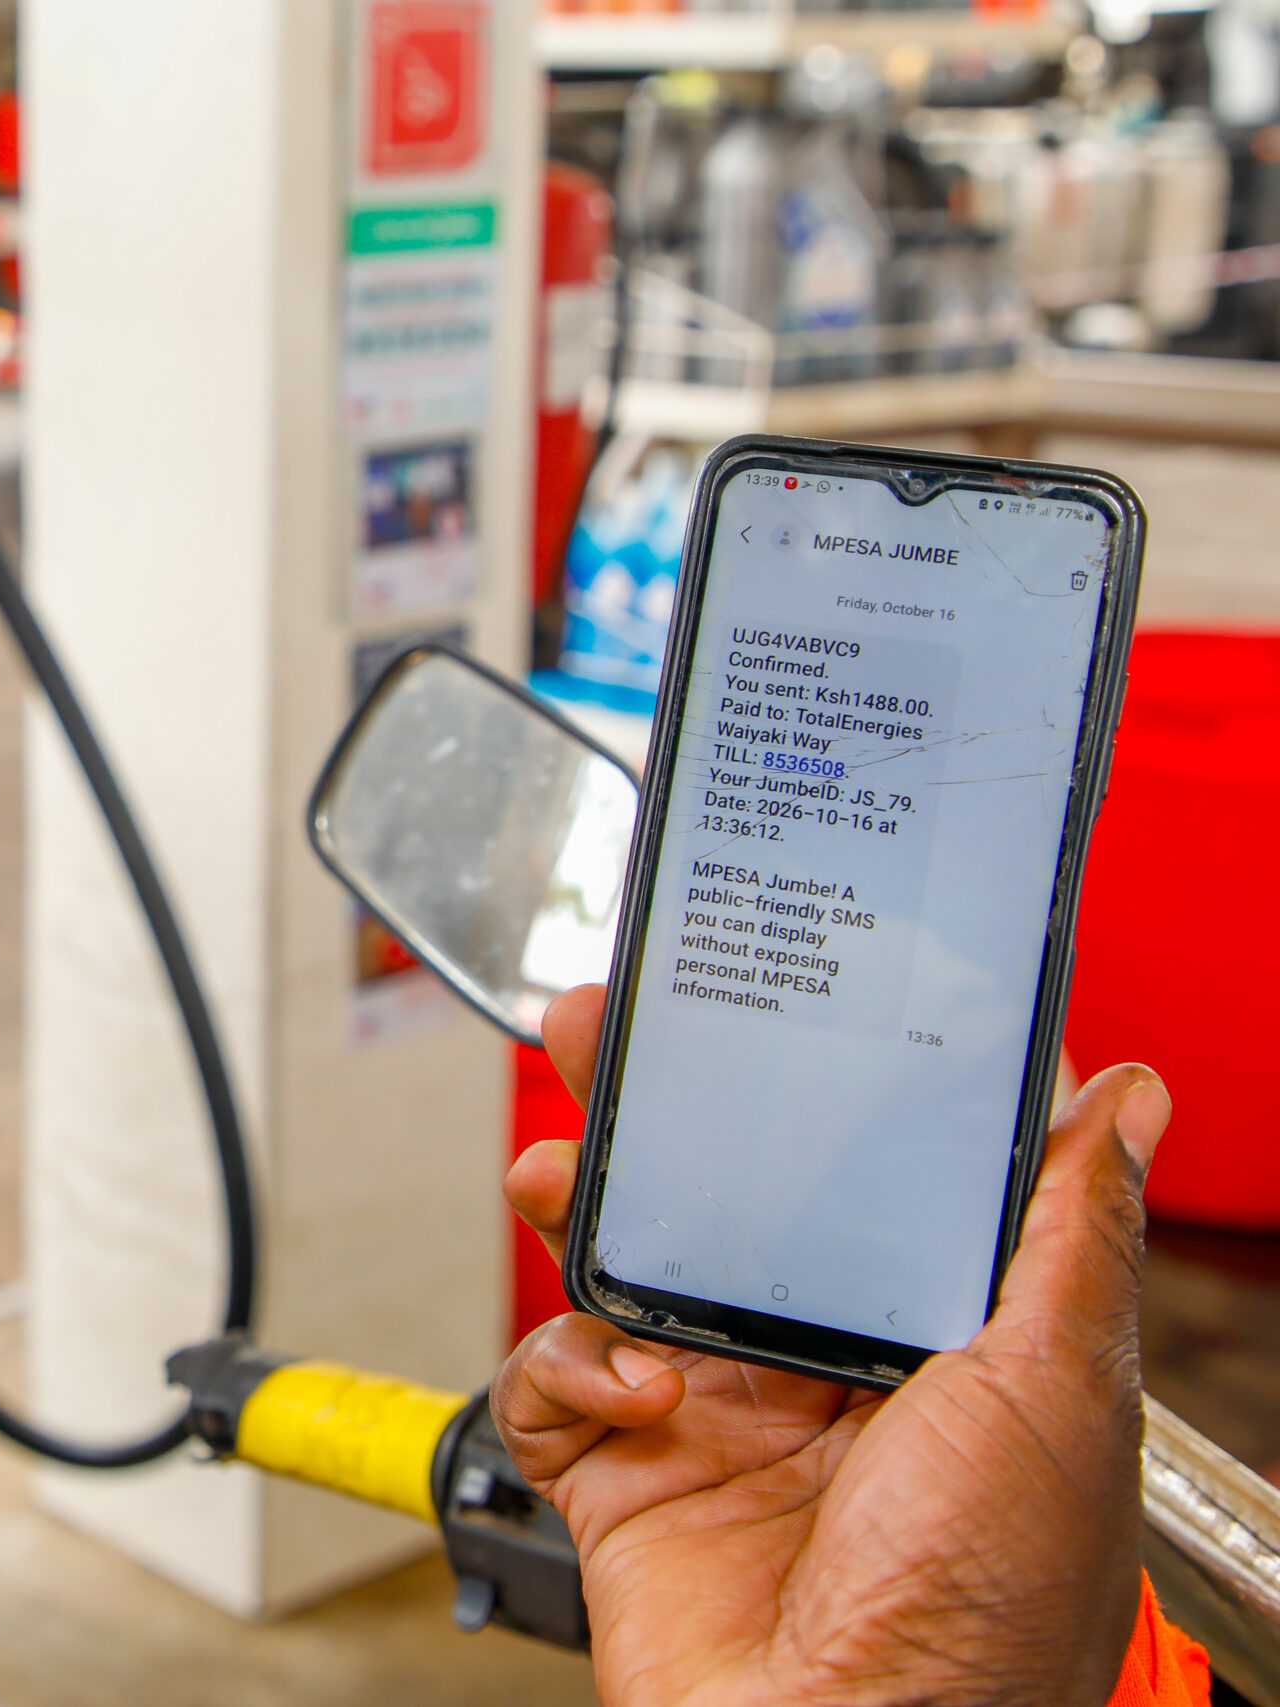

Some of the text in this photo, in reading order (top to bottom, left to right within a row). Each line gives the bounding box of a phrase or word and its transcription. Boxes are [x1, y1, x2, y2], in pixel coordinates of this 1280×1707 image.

[745, 474, 780, 487] 13:39
[1056, 507, 1083, 521] 77%
[814, 534, 959, 565] MPESA JUMBE
[837, 596, 955, 621] Friday, October 16
[733, 627, 860, 658] UJG4VABVC9
[729, 651, 829, 679] Confirmed.
[726, 674, 933, 717] You sent: Ksh1488.00.
[720, 697, 924, 740] Paid to: TotalEnergies
[717, 720, 831, 754] Waiyaki Way
[713, 744, 849, 780] TILL: 8536508.
[710, 767, 916, 813] Your JumbeID: JS_79.
[702, 815, 784, 842] 13:36:12.
[705, 791, 897, 834] Date: 2026-10-16 at
[693, 861, 856, 902] MPESA Jumbe! A
[688, 888, 876, 930] public-friendly SMS
[684, 911, 827, 949] you can display
[681, 934, 840, 976] without exposing
[676, 958, 831, 996] personal MPESA
[672, 978, 785, 1013] information.
[907, 1030, 943, 1047] 13:36
